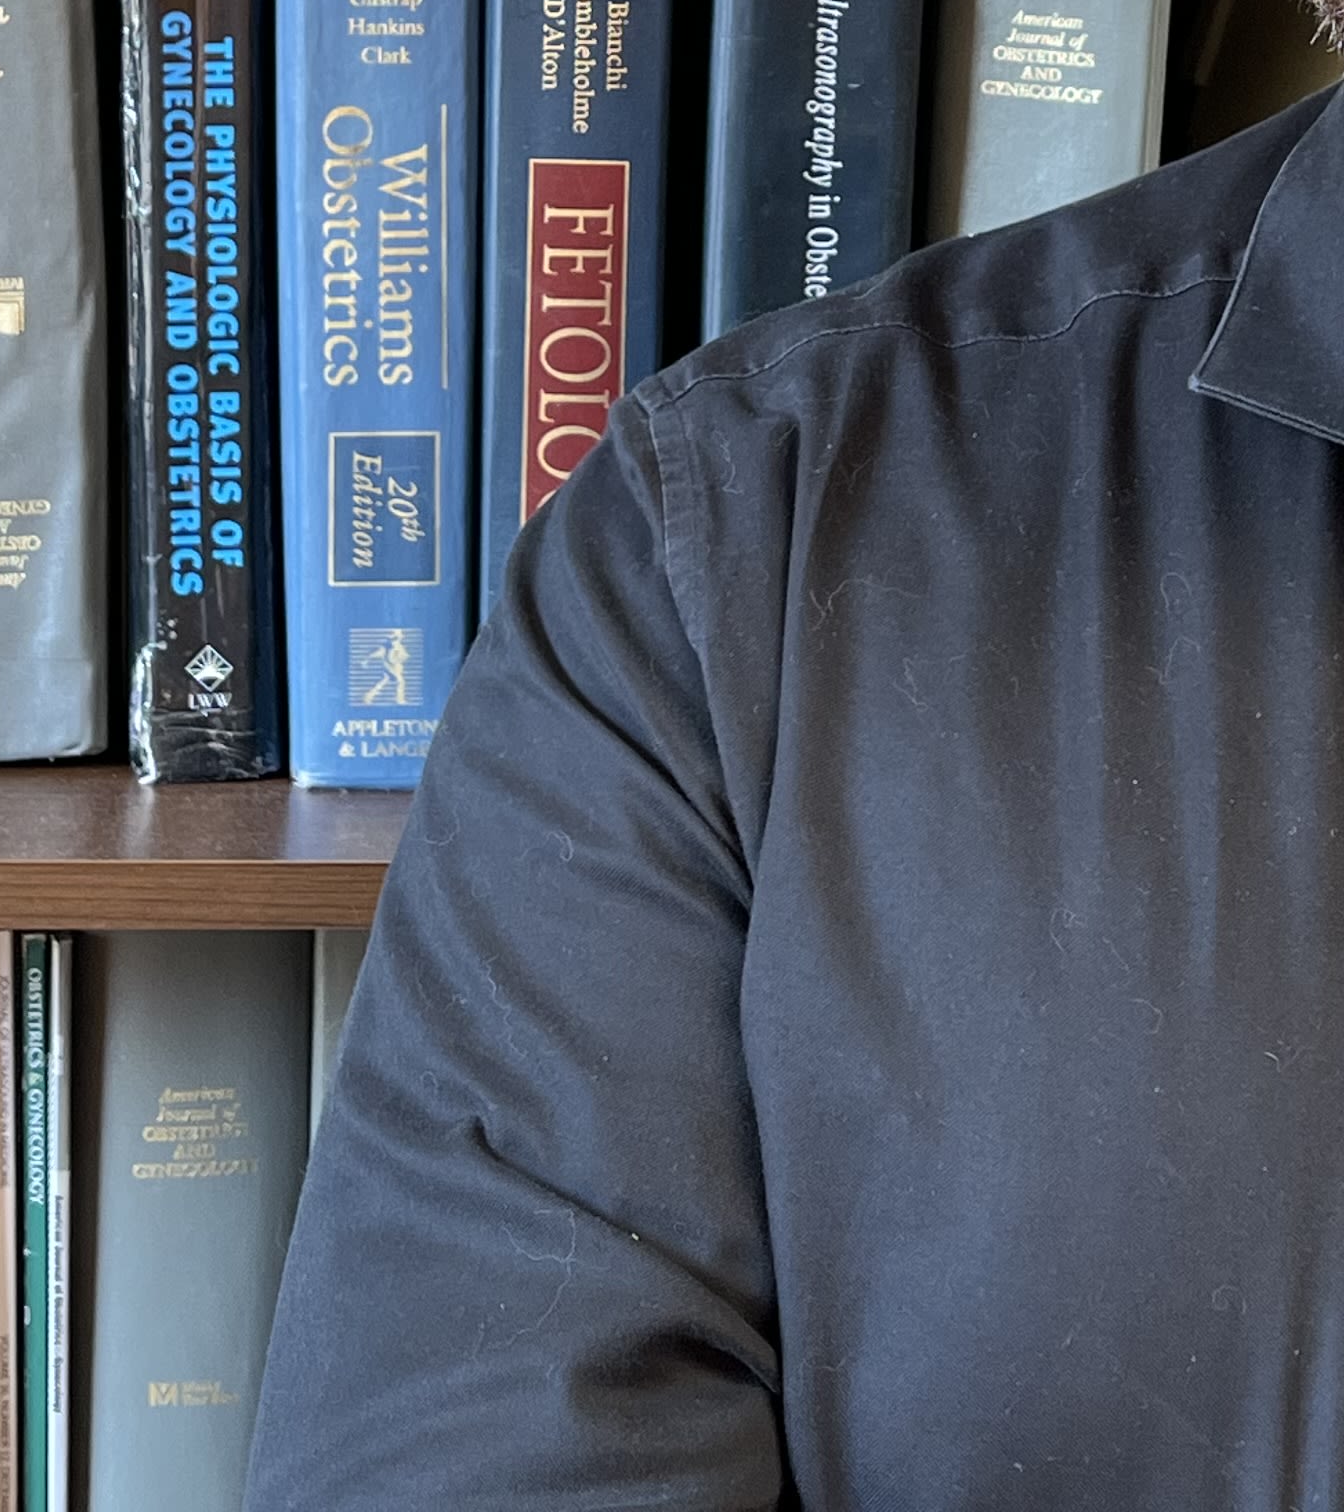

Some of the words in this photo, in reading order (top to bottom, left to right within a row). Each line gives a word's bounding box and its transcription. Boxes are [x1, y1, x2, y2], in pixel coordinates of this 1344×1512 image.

[348, 16, 424, 36] Hankins
[361, 45, 411, 64] Clark
[605, 0, 630, 93] Bianchi
[1006, 28, 1064, 47] Journal
[1069, 33, 1089, 51] of
[1011, 9, 1085, 29] American
[203, 37, 235, 108] THE
[992, 45, 1096, 68] OBSTETRICS
[1021, 66, 1063, 83] AND
[980, 80, 1104, 105] GYNECOLOGY
[160, 10, 197, 257] GYNECOLOGY
[808, 194, 841, 219] in
[206, 124, 240, 376] PHYSIOLOGIC
[322, 105, 374, 386] Obstetrics
[377, 143, 428, 385] Williams
[804, 226, 839, 298] Obste
[165, 271, 198, 350] AND
[536, 202, 616, 509] FETOLO
[167, 364, 204, 596] OBSTETRICS
[208, 391, 242, 505] BASIS
[211, 518, 243, 568] OF
[352, 451, 383, 569] Edition
[386, 476, 426, 543] 20th
[331, 719, 440, 737] APPLETON
[338, 740, 356, 758] &
[28, 967, 44, 1068] OBSTETRICS
[28, 1088, 44, 1205] GYNECOLOGY
